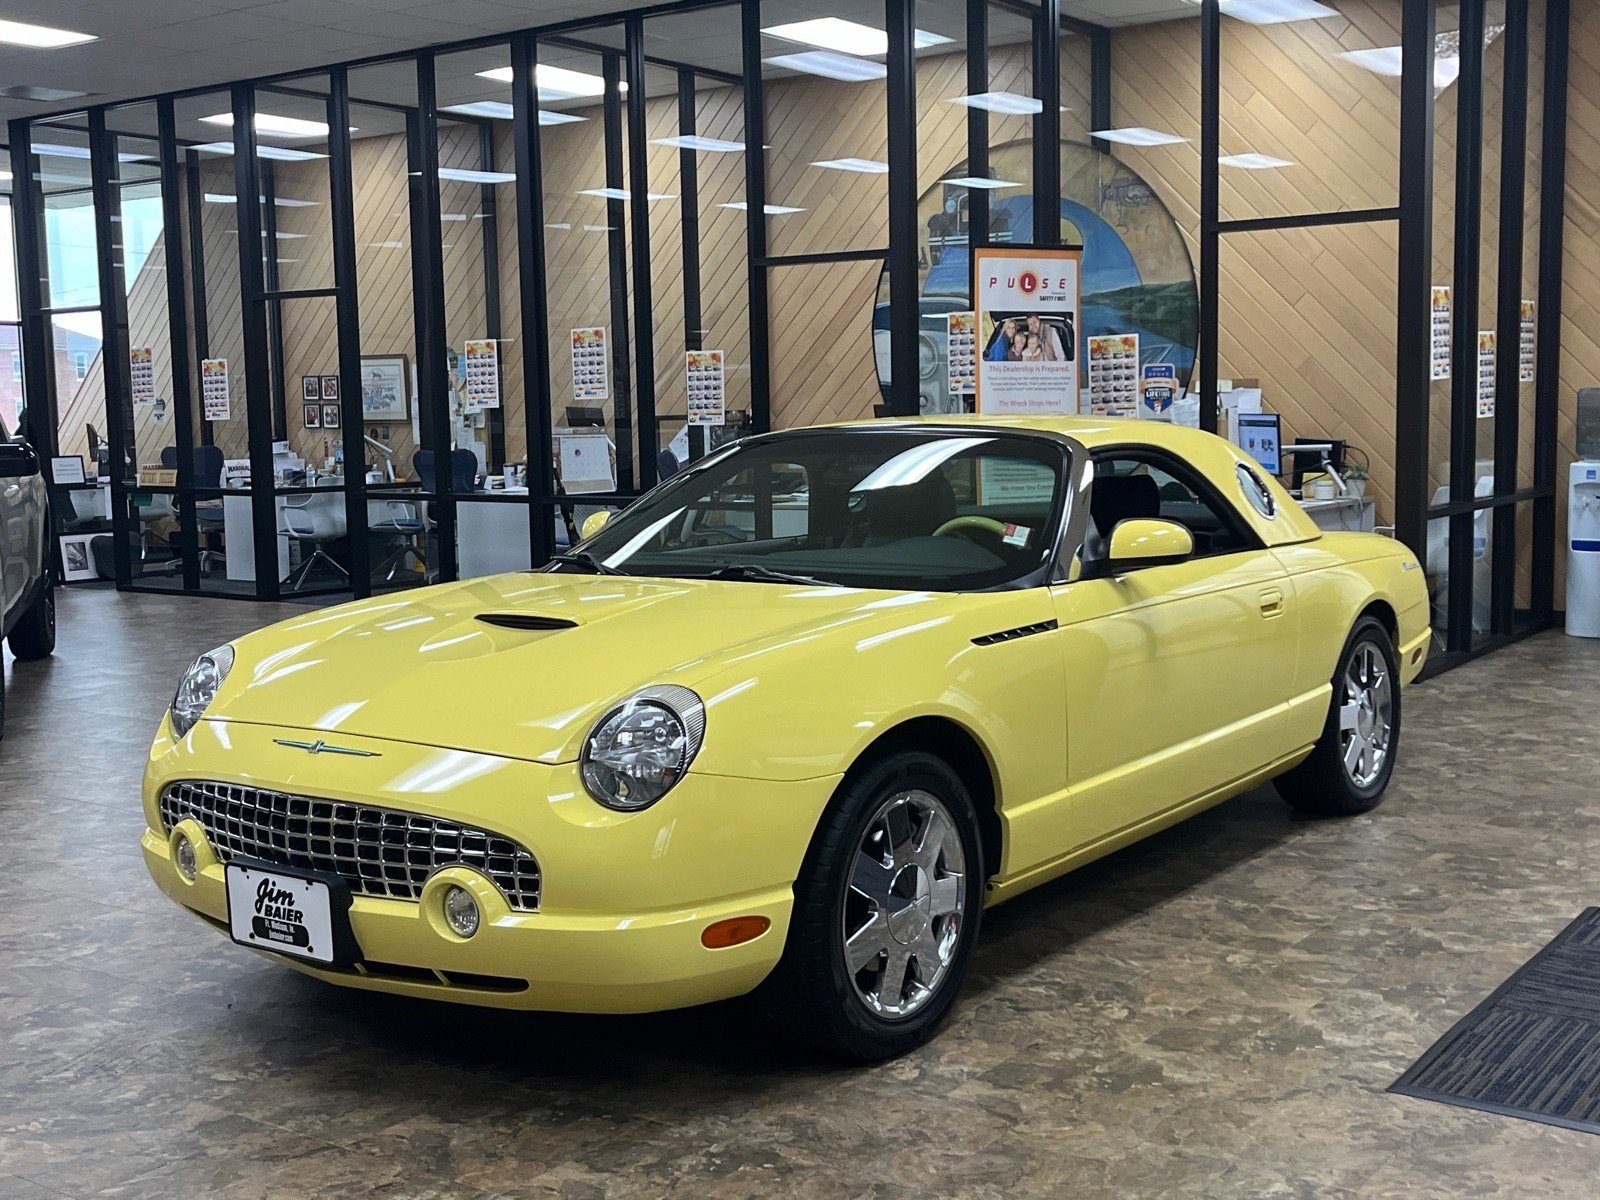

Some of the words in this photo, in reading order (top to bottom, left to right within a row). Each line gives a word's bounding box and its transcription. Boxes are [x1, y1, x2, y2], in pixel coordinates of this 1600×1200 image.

[989, 277, 1066, 291] PULSE
[1003, 365, 1034, 373] Dealership
[255, 878, 295, 914] Jim
[264, 905, 303, 923] BAIER
